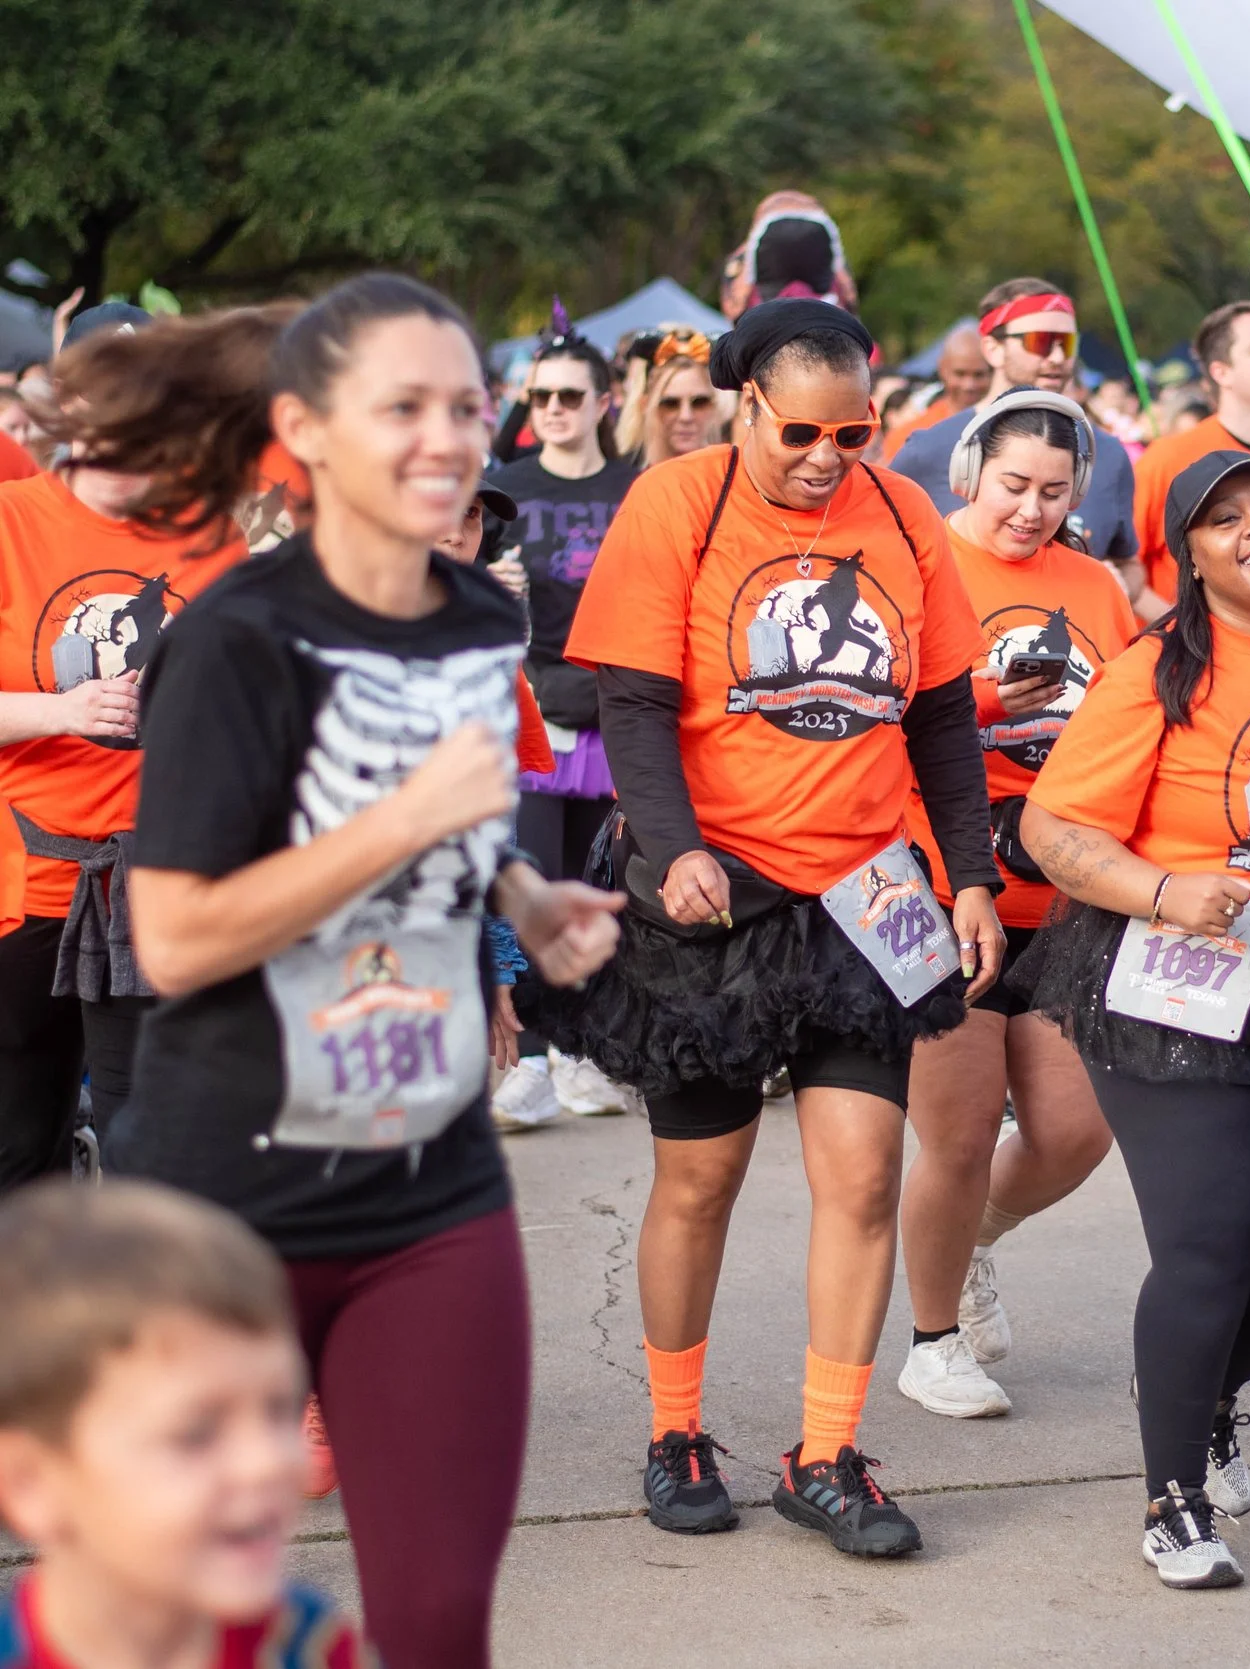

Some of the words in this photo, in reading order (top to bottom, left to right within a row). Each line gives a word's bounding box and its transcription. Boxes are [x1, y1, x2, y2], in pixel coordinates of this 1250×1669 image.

[809, 684, 851, 701] MONSTER
[851, 694, 875, 710] DASH
[788, 710, 851, 737] 2025
[876, 896, 937, 958] 225
[926, 926, 950, 949] TEXANS
[1142, 935, 1242, 991] 1097
[1186, 988, 1229, 1008] TEXANS
[319, 1015, 449, 1095] 1181
